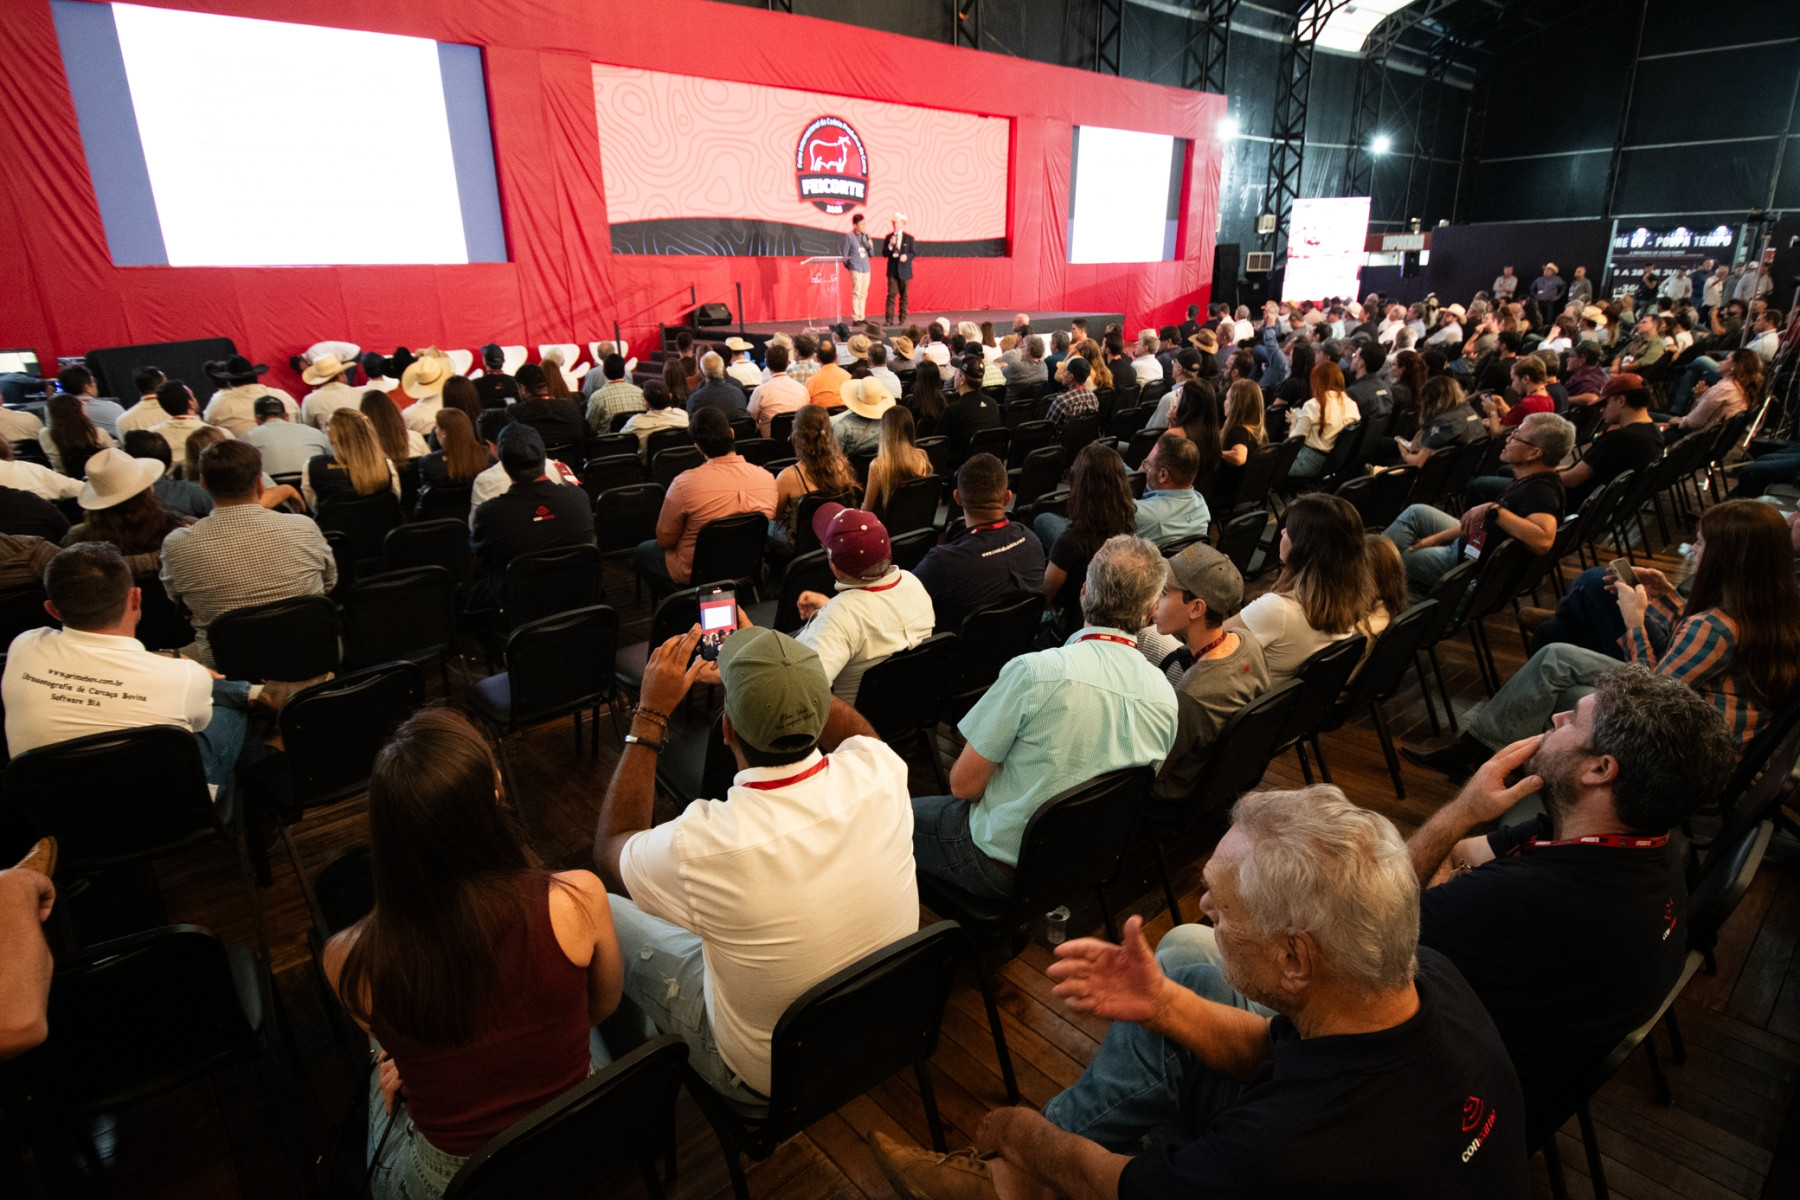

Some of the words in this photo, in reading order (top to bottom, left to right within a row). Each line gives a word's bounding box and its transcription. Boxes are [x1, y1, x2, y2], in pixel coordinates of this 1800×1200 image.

[801, 178, 865, 198] FEICORTE
[1382, 234, 1425, 251] IMPRENSA
[1655, 235, 1691, 248] POUPA
[1693, 234, 1733, 247] TEMPO
[51, 693, 83, 705] Software
[87, 698, 101, 708] BIA
[76, 686, 85, 694] de
[88, 687, 118, 699] Carcaça
[122, 692, 147, 702] Bovina
